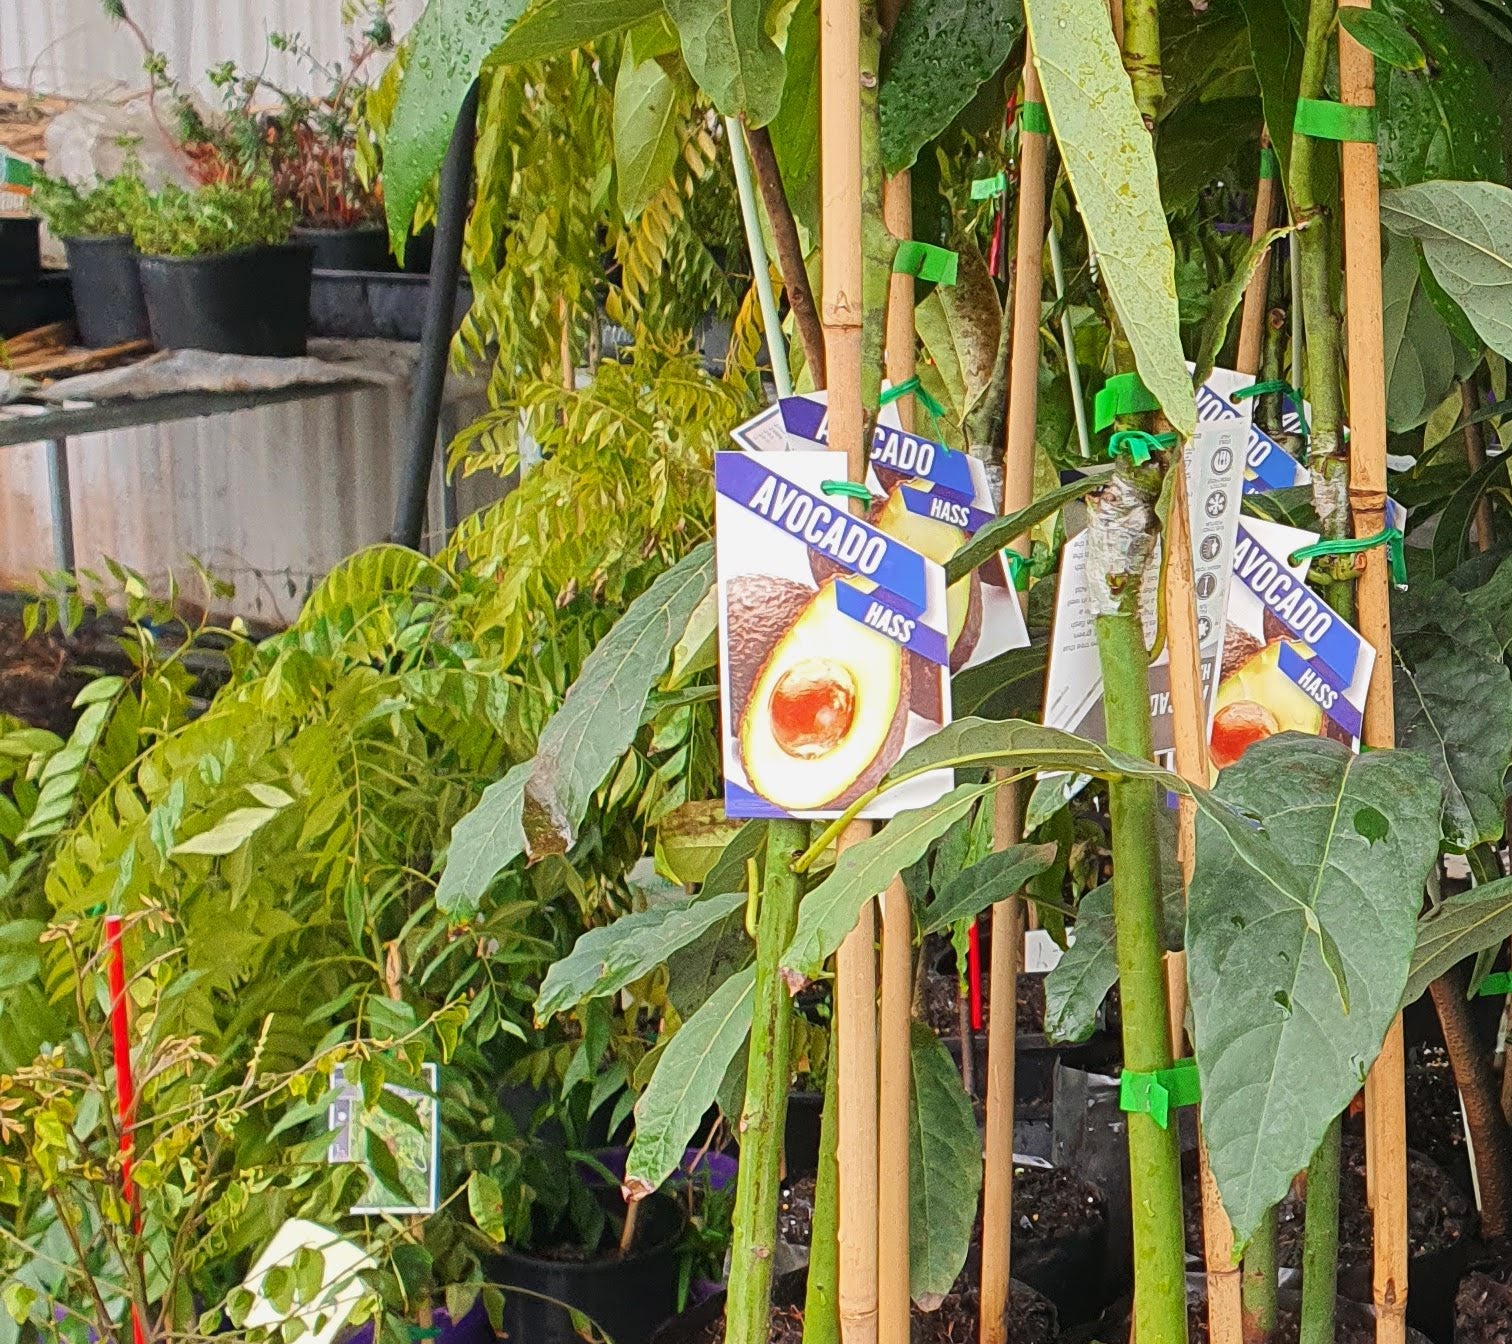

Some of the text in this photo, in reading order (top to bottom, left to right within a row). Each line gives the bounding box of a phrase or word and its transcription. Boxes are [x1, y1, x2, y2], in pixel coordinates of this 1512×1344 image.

[749, 474, 887, 576] AVOCADO
[930, 497, 971, 527] HASS
[1233, 540, 1334, 645] AVOCADO
[864, 600, 916, 644] HASS
[1297, 666, 1339, 710] HASS
